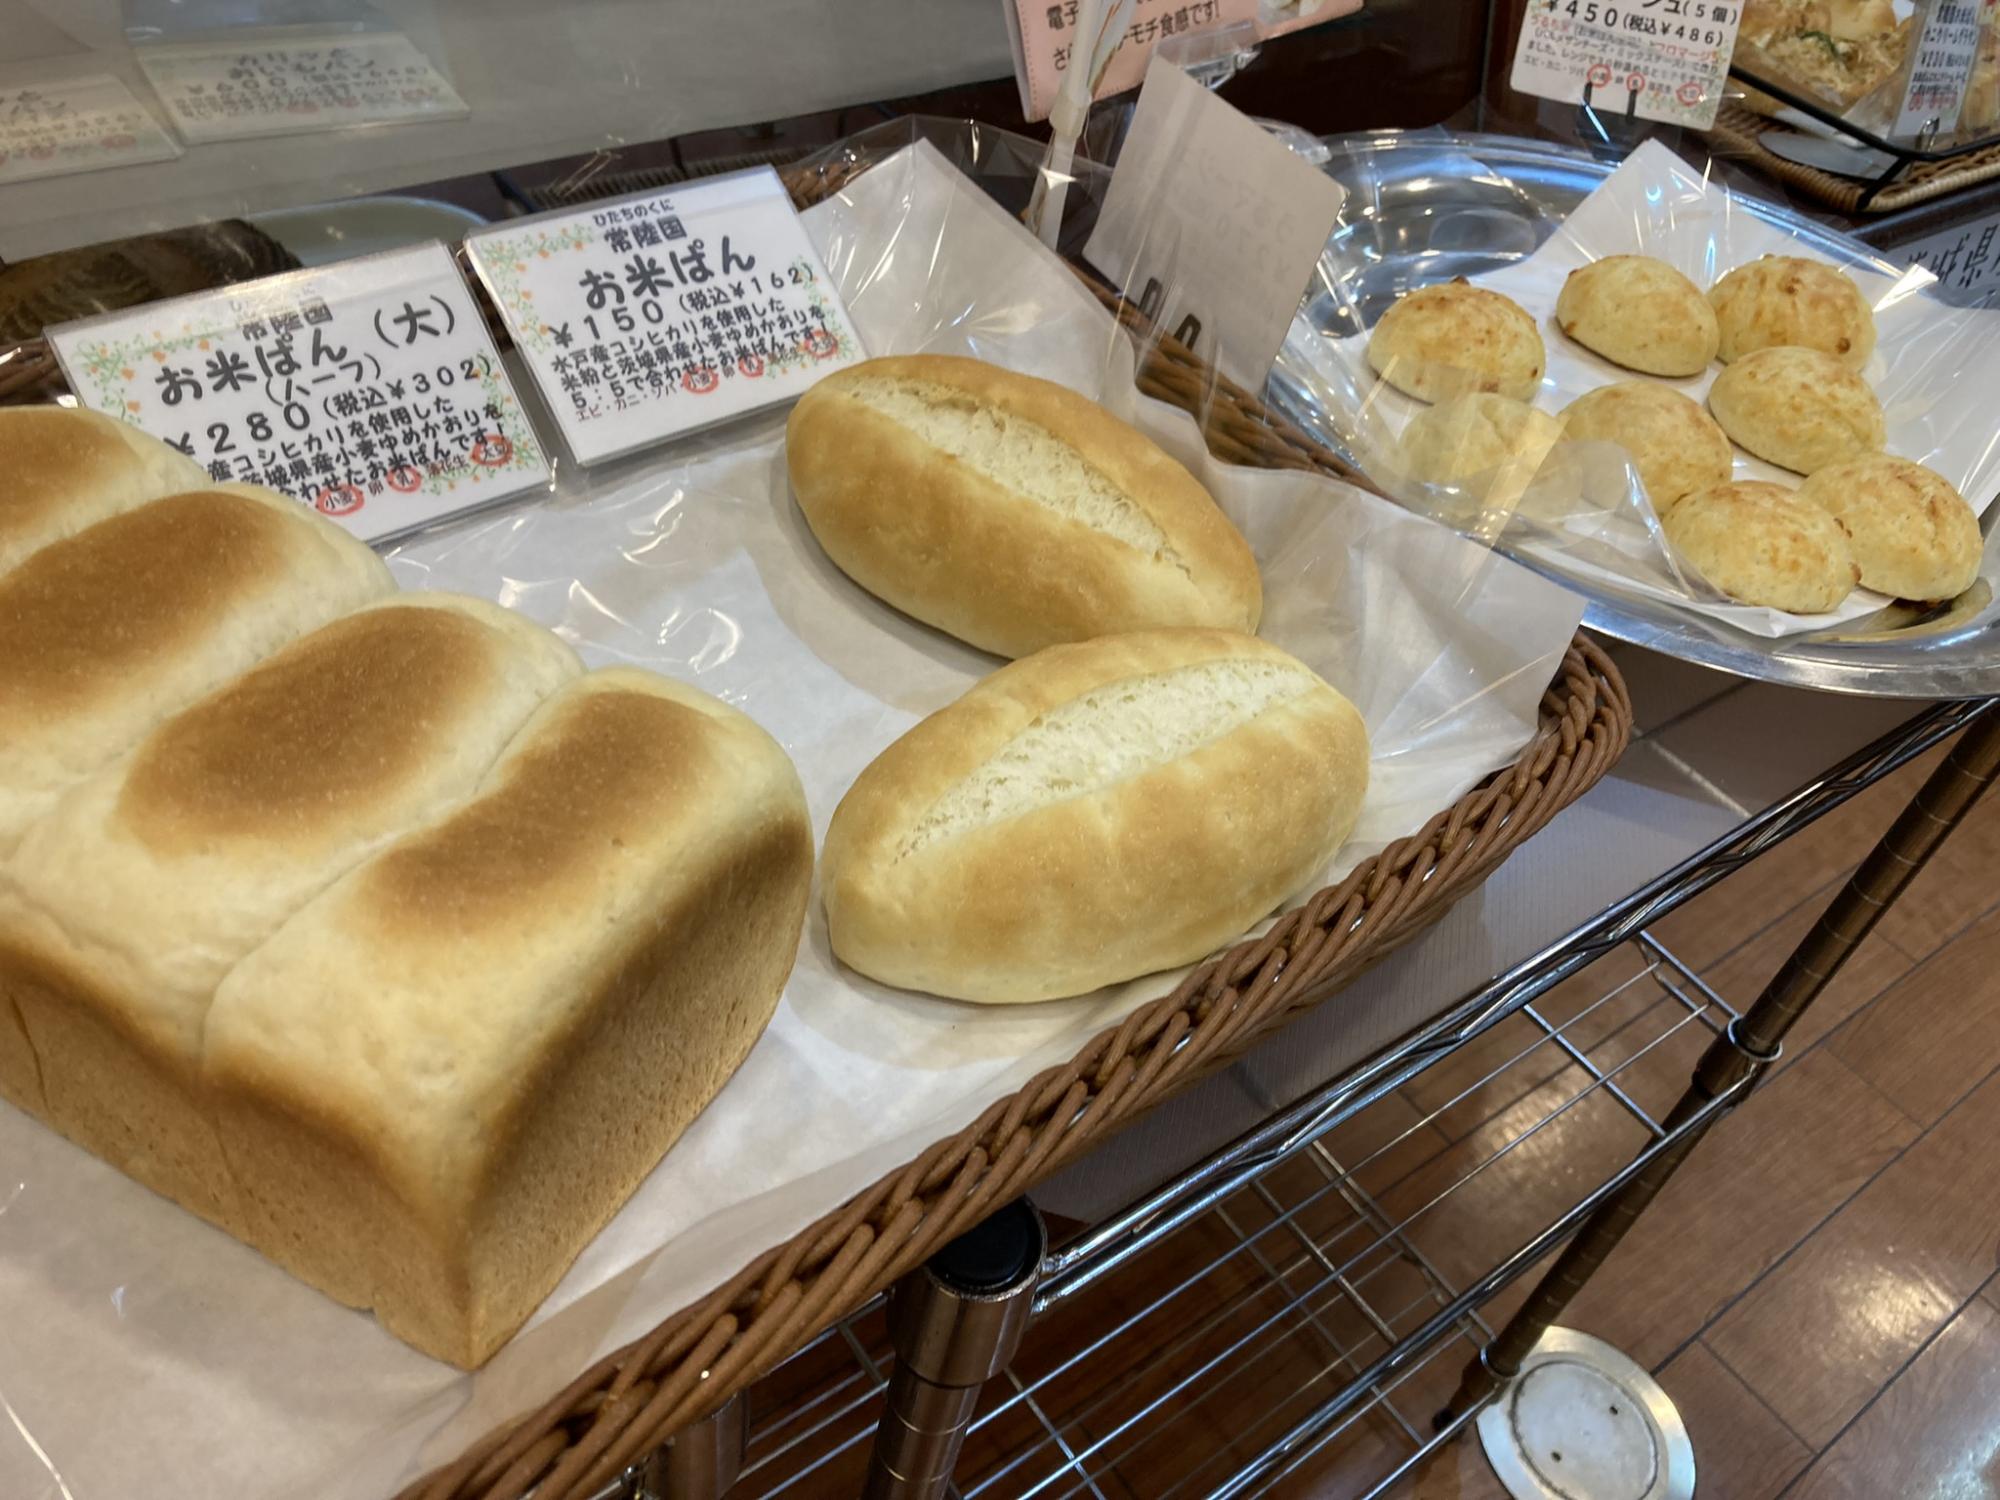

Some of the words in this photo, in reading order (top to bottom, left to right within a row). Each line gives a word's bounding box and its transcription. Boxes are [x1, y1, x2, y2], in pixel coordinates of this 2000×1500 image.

[592, 199, 675, 227] ひたちのくに
[604, 214, 688, 254] 常陸国
[547, 299, 665, 348] ¥150
[678, 262, 814, 314] (税込¥162)
[578, 235, 756, 310] お米ぱん
[154, 328, 348, 406] お米ぱん
[373, 294, 456, 349] (大)
[552, 297, 786, 375] 水戸産コシヒカリを使用した
[265, 352, 382, 407] (ハーフ)
[322, 353, 491, 421] (税込¥302)
